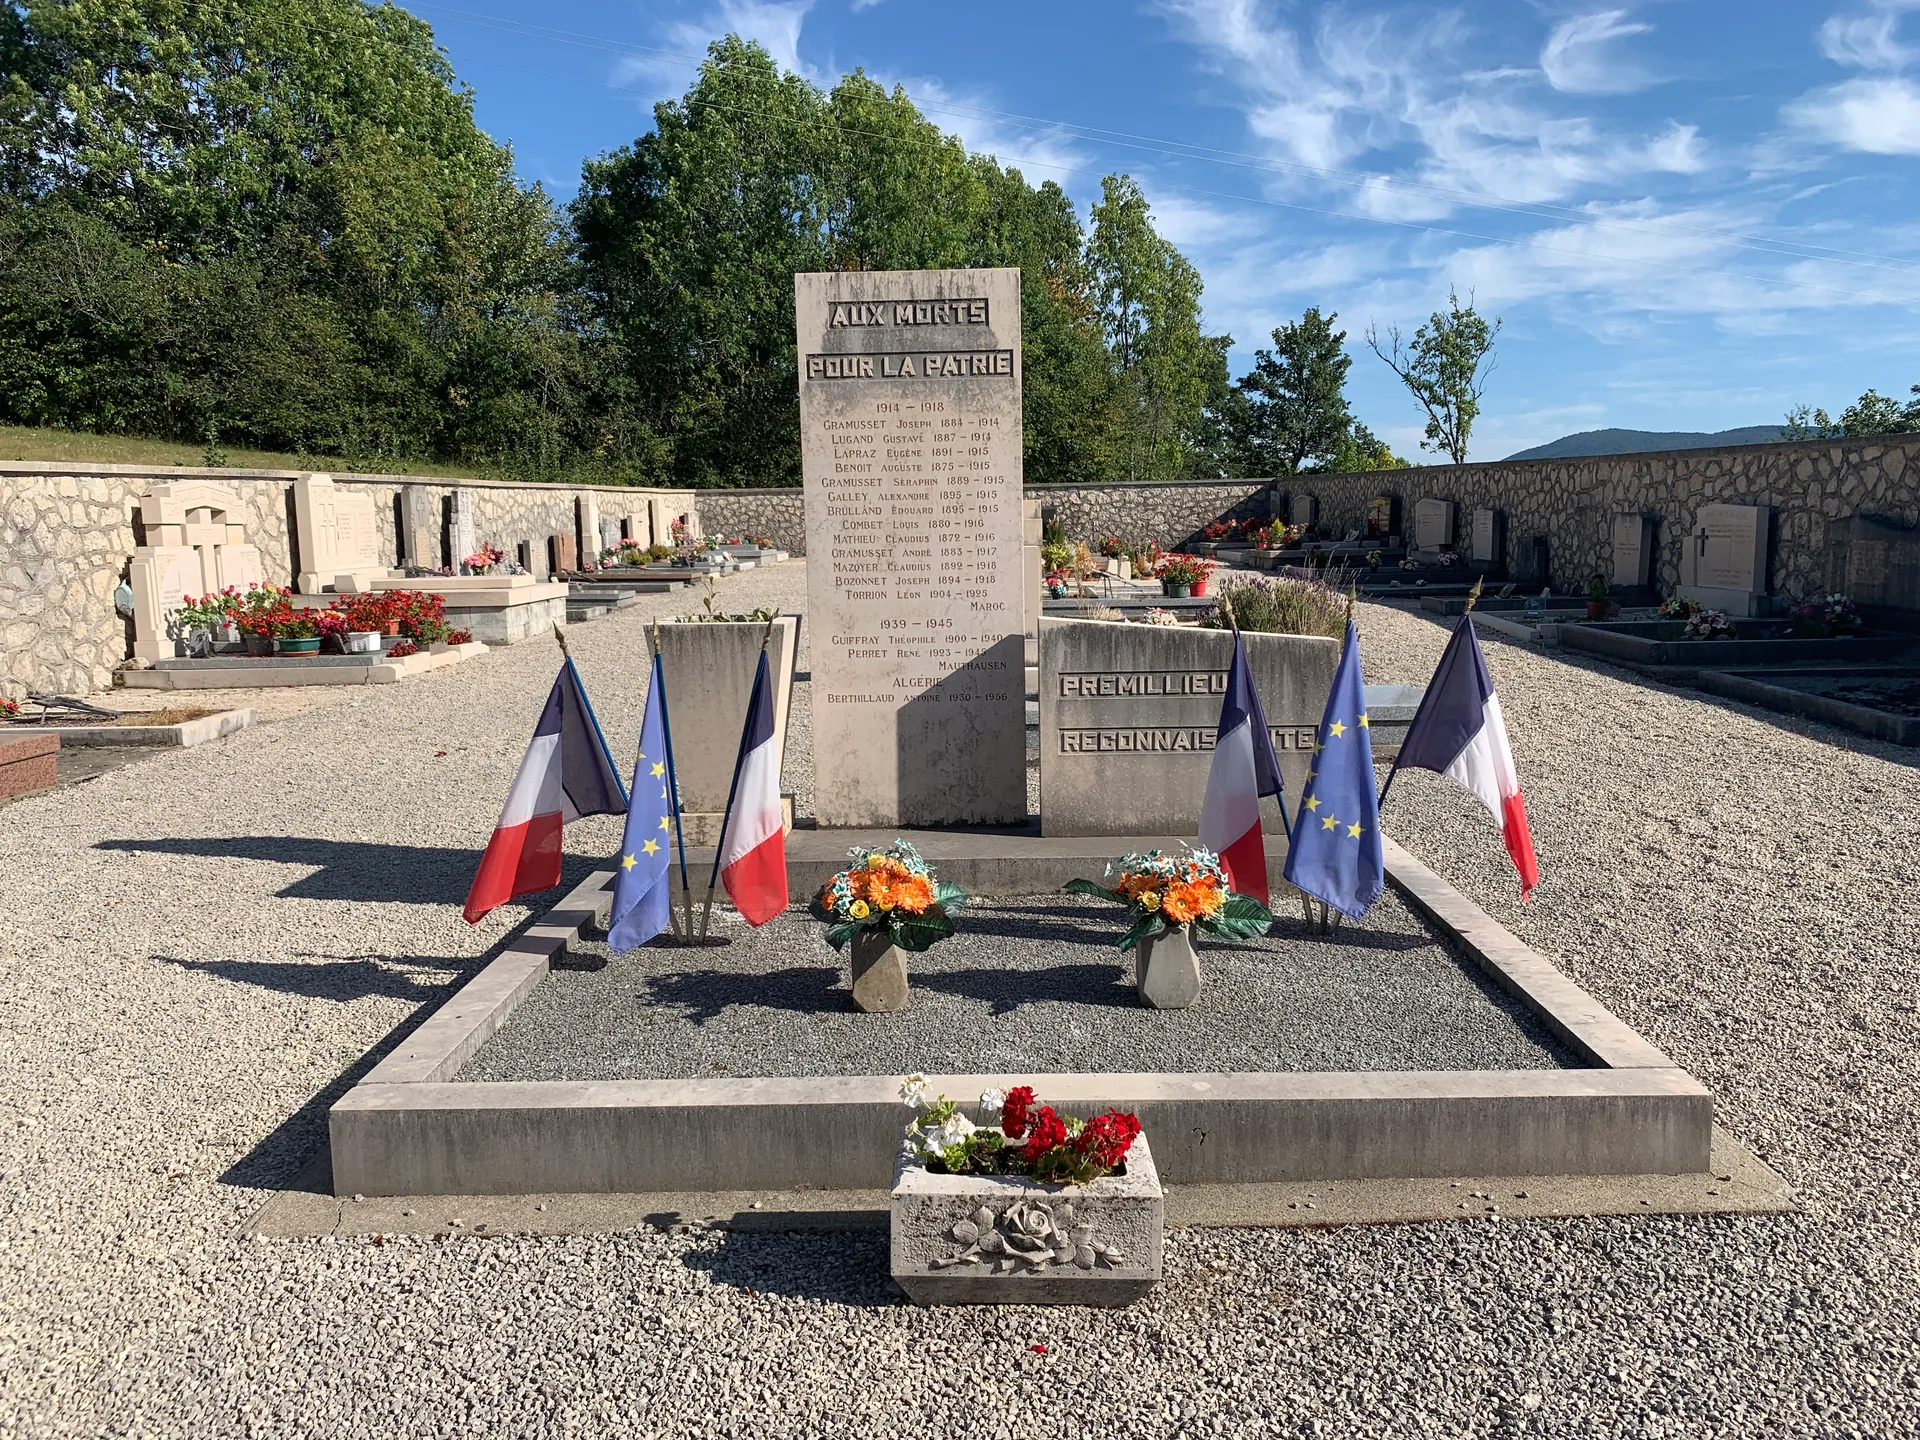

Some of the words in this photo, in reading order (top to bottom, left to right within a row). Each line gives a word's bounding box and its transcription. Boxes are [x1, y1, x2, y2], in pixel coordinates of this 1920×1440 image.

[831, 304, 885, 326] AUX
[894, 302, 986, 324] MORTS
[808, 357, 874, 378] POUR
[882, 356, 916, 378] LA
[924, 352, 1010, 376] PATRIE
[876, 403, 900, 413] 1914
[921, 402, 944, 412] 1918
[823, 420, 886, 430] GRAMUSSET
[896, 419, 931, 428] JOSEPH
[941, 419, 963, 427] 1884
[978, 418, 999, 427] 1914
[831, 434, 873, 444] LUGAND
[933, 434, 956, 443] 1887
[971, 433, 991, 442] 1914
[834, 449, 876, 459] LAPRAZ
[932, 449, 952, 457] 1891
[968, 448, 988, 456] 1915
[835, 463, 872, 473] BENOIT
[881, 464, 922, 472] AUGUSTE
[931, 463, 954, 471] 1875
[969, 462, 990, 470] 1915
[822, 478, 883, 487] GRAMUSSET
[894, 478, 938, 486] SÉRAPHIN
[947, 477, 969, 485] 1889
[983, 476, 1004, 485] 1915
[828, 492, 868, 502] GALLEY
[878, 492, 929, 501] ALEXANDRE
[940, 491, 961, 500] 1895
[976, 491, 997, 499] 1915
[942, 505, 964, 514] 1895
[978, 505, 999, 513] 1915
[843, 520, 883, 530] COMBET
[893, 521, 919, 529] LOUIS
[928, 520, 951, 528] 1880
[964, 520, 984, 528] 1916
[833, 535, 875, 544] MATHIEU
[886, 535, 930, 543] CLAUDIUS
[939, 534, 961, 543] 1872
[975, 533, 995, 542] 1916
[832, 549, 893, 558] GRAMUSSET
[902, 549, 932, 557] ANDRÉ
[977, 548, 997, 556] 1917
[833, 563, 878, 572] MAZOYER
[888, 563, 931, 571] CLAUDIUS
[941, 562, 963, 571] 1892
[977, 562, 997, 570] 1918
[835, 577, 887, 586] BOZONNET
[895, 577, 930, 585] JOSEPH
[938, 576, 961, 585] 1894
[975, 576, 995, 584] 1918
[846, 590, 887, 599] TORRION
[930, 590, 951, 598] 1904
[966, 590, 988, 598] 1925
[970, 601, 1006, 611] MAROC
[880, 619, 907, 629] 1939
[926, 619, 952, 628] 1945
[832, 636, 879, 645] GUIFFRAY
[889, 635, 936, 644] THÉOPHILE
[945, 635, 967, 643] 1900
[981, 634, 1003, 643] 1940
[848, 649, 888, 658] PERRET
[897, 649, 920, 658] RENÉ
[930, 649, 951, 657] 1923
[938, 661, 1007, 671] MAUTHAUSEN
[893, 674, 943, 688] ALGÉRIE
[1062, 674, 1227, 696] PREMILLIEU
[828, 694, 894, 703] BERTHILLAUD
[903, 694, 941, 702] ANTOINE
[949, 693, 971, 702] 1930
[985, 693, 1008, 701] 1956
